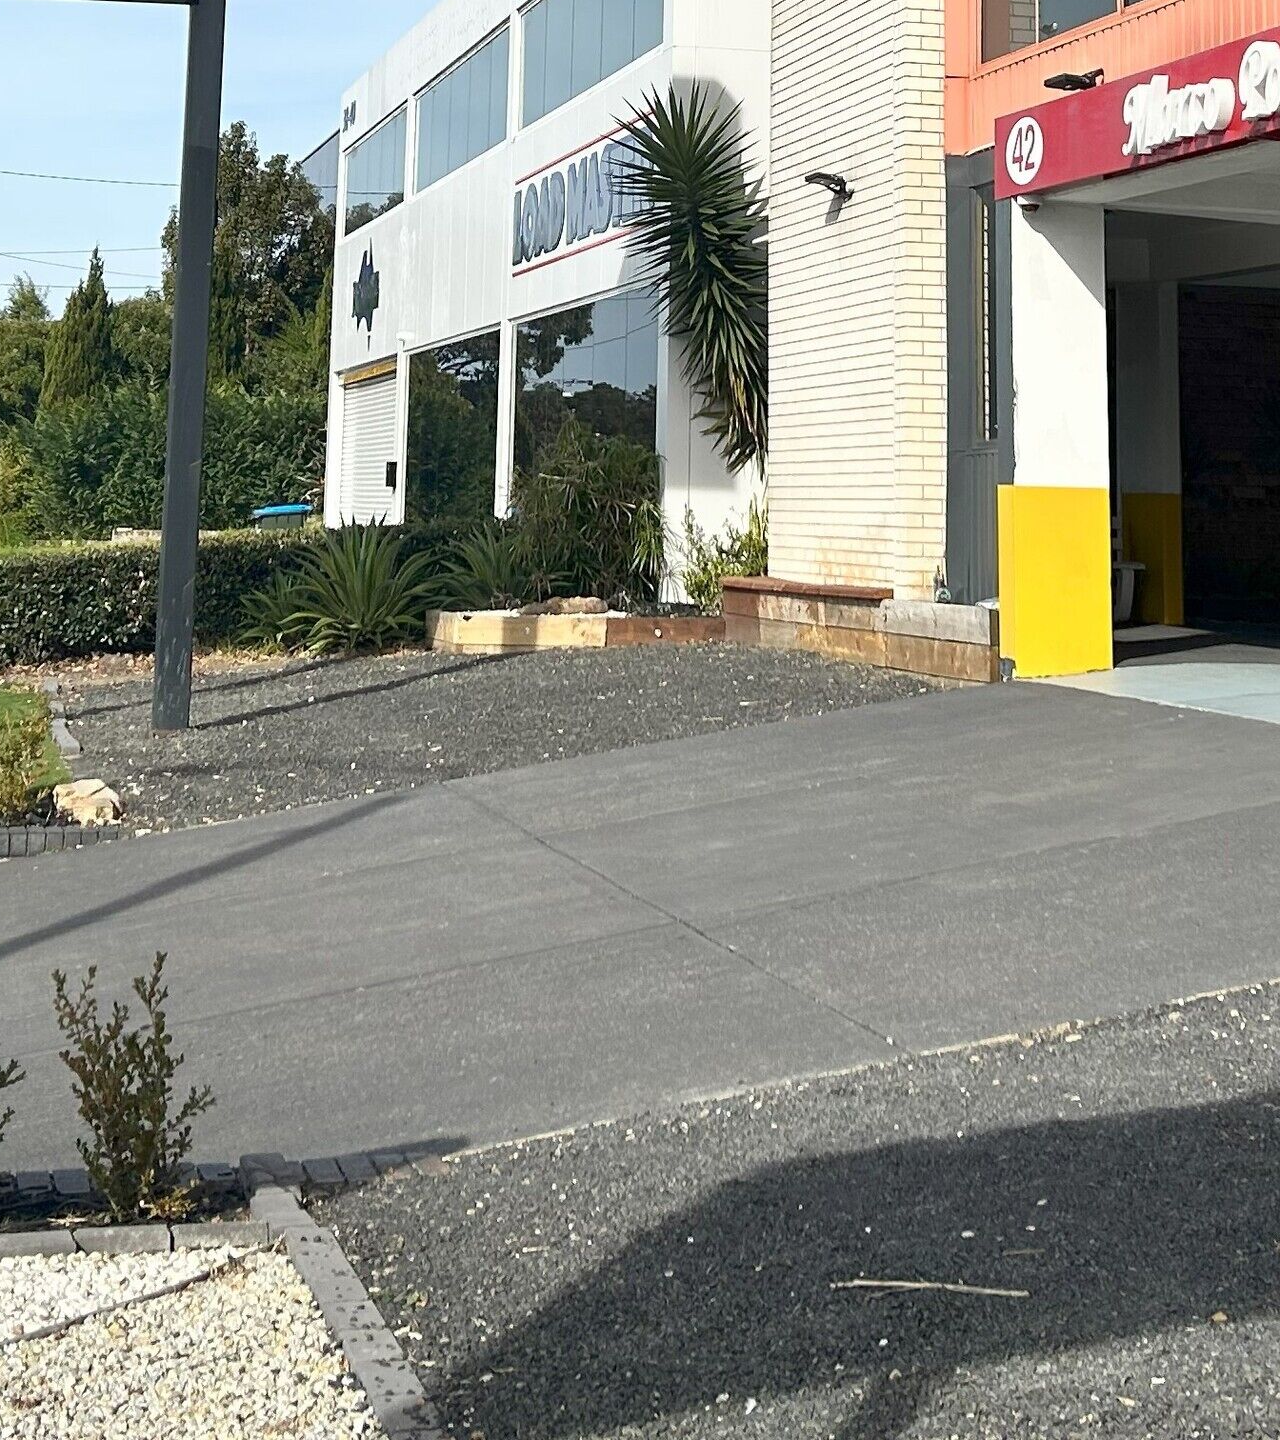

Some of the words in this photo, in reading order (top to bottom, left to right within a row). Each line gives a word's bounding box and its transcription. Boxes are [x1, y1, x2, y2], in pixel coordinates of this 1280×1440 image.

[1011, 123, 1036, 172] 42
[1122, 75, 1235, 156] Marco
[513, 171, 566, 266] LOAD
